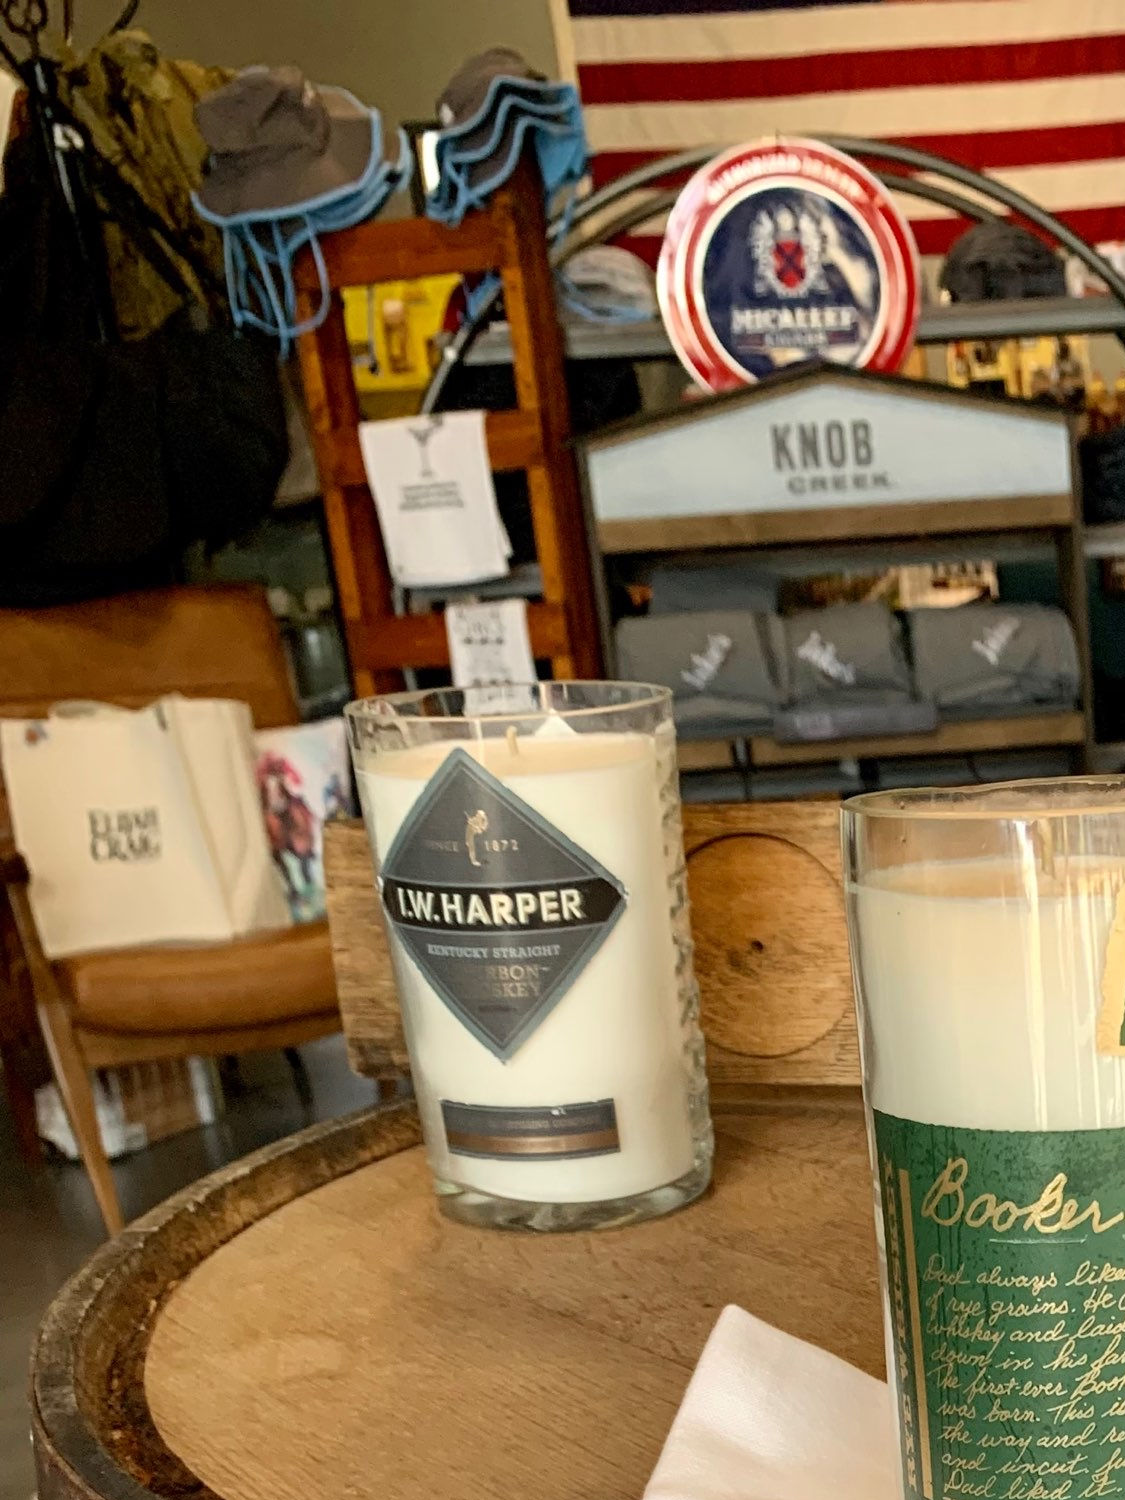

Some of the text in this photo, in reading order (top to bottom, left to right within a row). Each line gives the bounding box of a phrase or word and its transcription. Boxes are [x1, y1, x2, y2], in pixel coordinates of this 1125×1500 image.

[770, 419, 873, 472] KNOB
[484, 839, 519, 852] 1872
[428, 944, 560, 959] KENTUCKY STRAIGHT
[922, 1253, 970, 1285] Dad
[976, 1265, 1058, 1297] always
[947, 1295, 987, 1324] rye
[990, 1296, 1076, 1327] grains.
[1083, 1284, 1117, 1314] He
[1009, 1320, 1070, 1342] and
[931, 1342, 993, 1367] down
[995, 1351, 1034, 1371] in
[1043, 1339, 1089, 1371] his
[927, 1364, 962, 1390] The
[938, 1400, 976, 1419] was
[984, 1398, 1041, 1423] born.
[1047, 1397, 1095, 1424] This
[938, 1420, 973, 1444] the
[976, 1435, 1033, 1464] way
[1036, 1422, 1098, 1448] and
[941, 1453, 992, 1472] and
[995, 1453, 1090, 1476] uncut.
[943, 1469, 997, 1499] Dad
[999, 1475, 1073, 1500] liked
